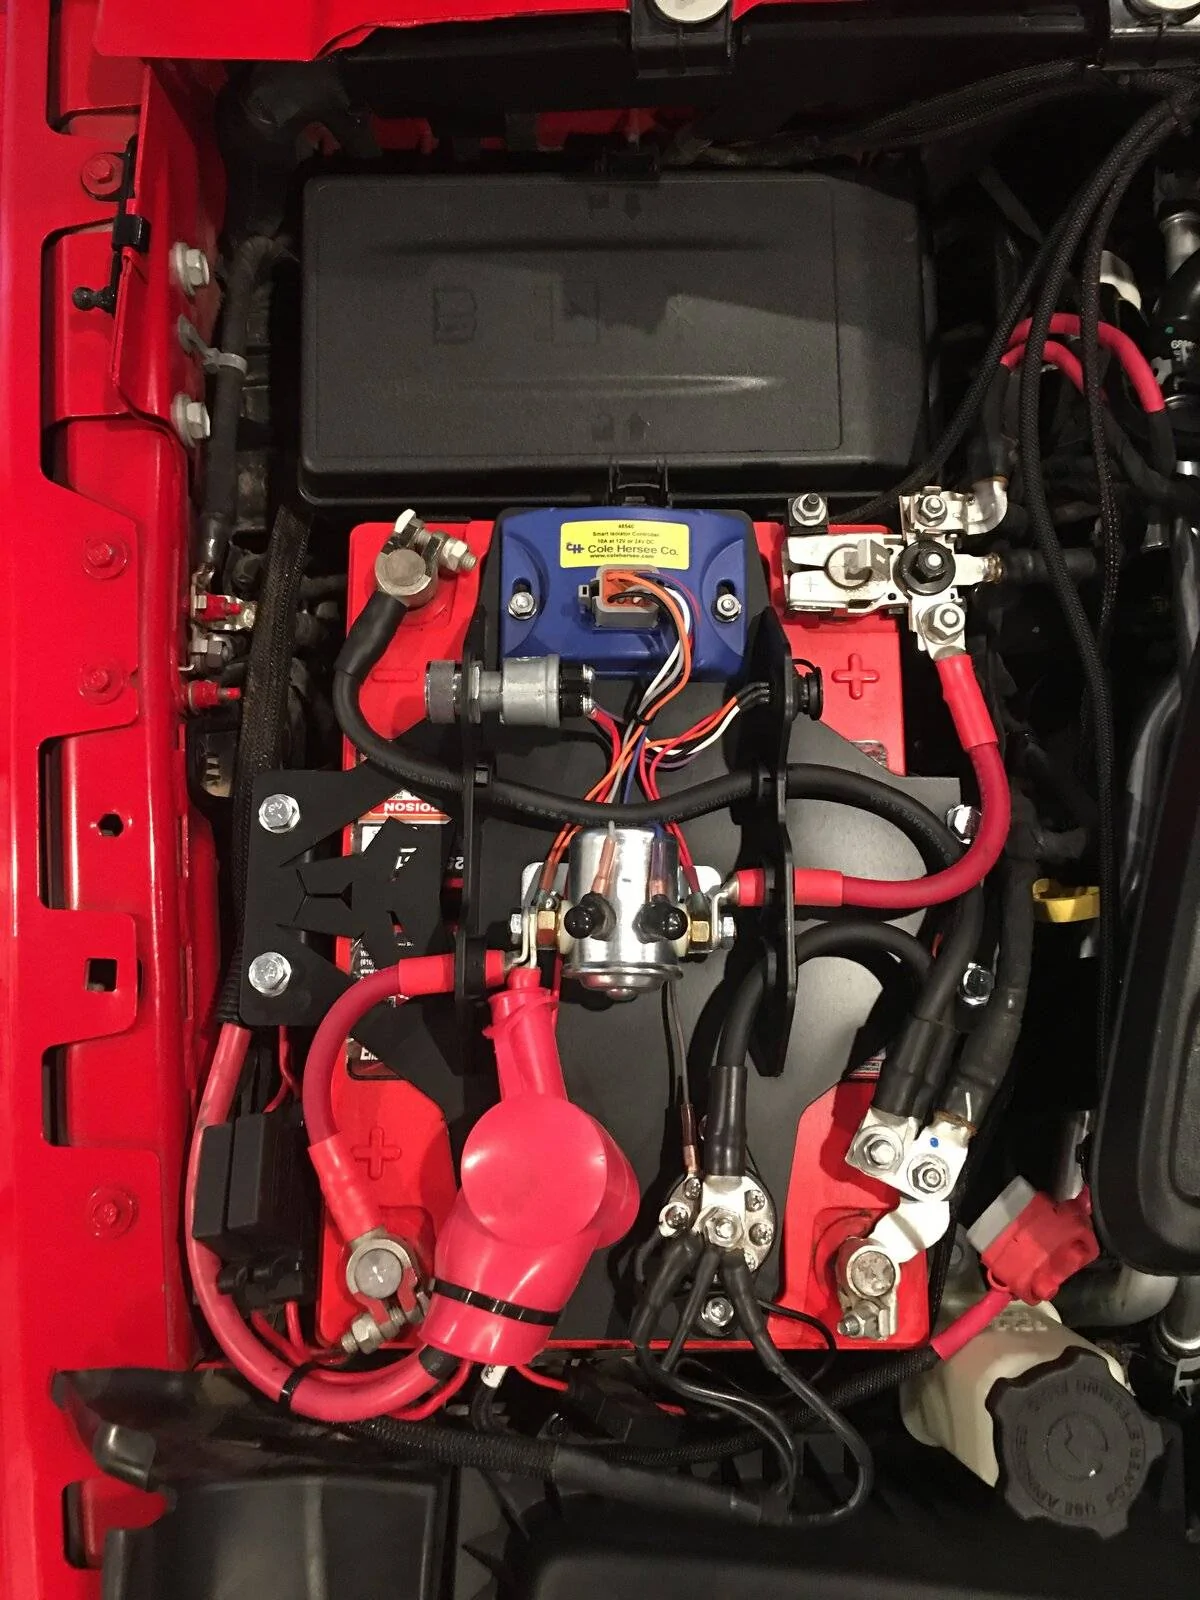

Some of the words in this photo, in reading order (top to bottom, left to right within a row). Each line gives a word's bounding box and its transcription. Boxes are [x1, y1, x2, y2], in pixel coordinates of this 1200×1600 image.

[588, 545, 614, 554] Cole
[617, 545, 658, 554] Hersee
[660, 546, 679, 556] Co.
